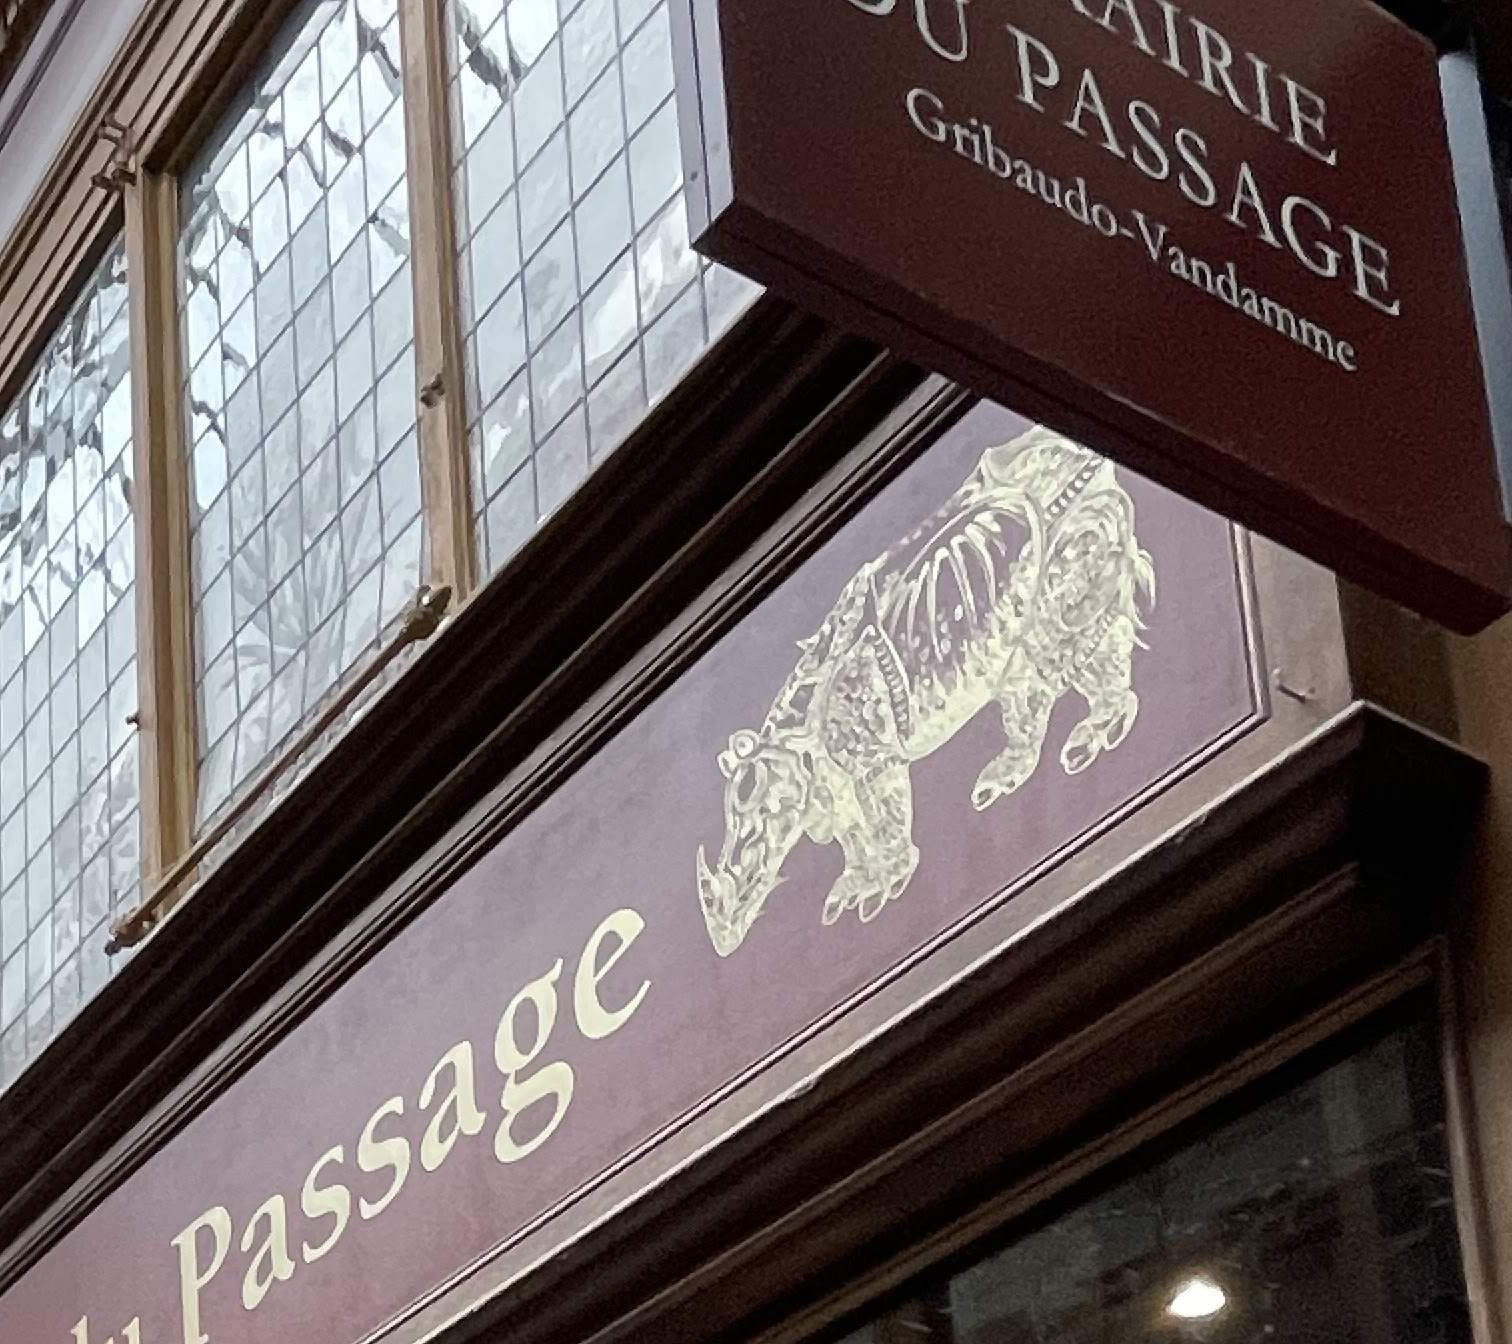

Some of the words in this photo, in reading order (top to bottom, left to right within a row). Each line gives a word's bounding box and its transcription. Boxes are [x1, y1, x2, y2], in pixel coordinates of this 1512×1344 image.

[1005, 23, 1400, 317] PASSAGE
[1070, 0, 1337, 167] AIRIE
[905, 87, 1358, 373] Gribaudo-Vandamme
